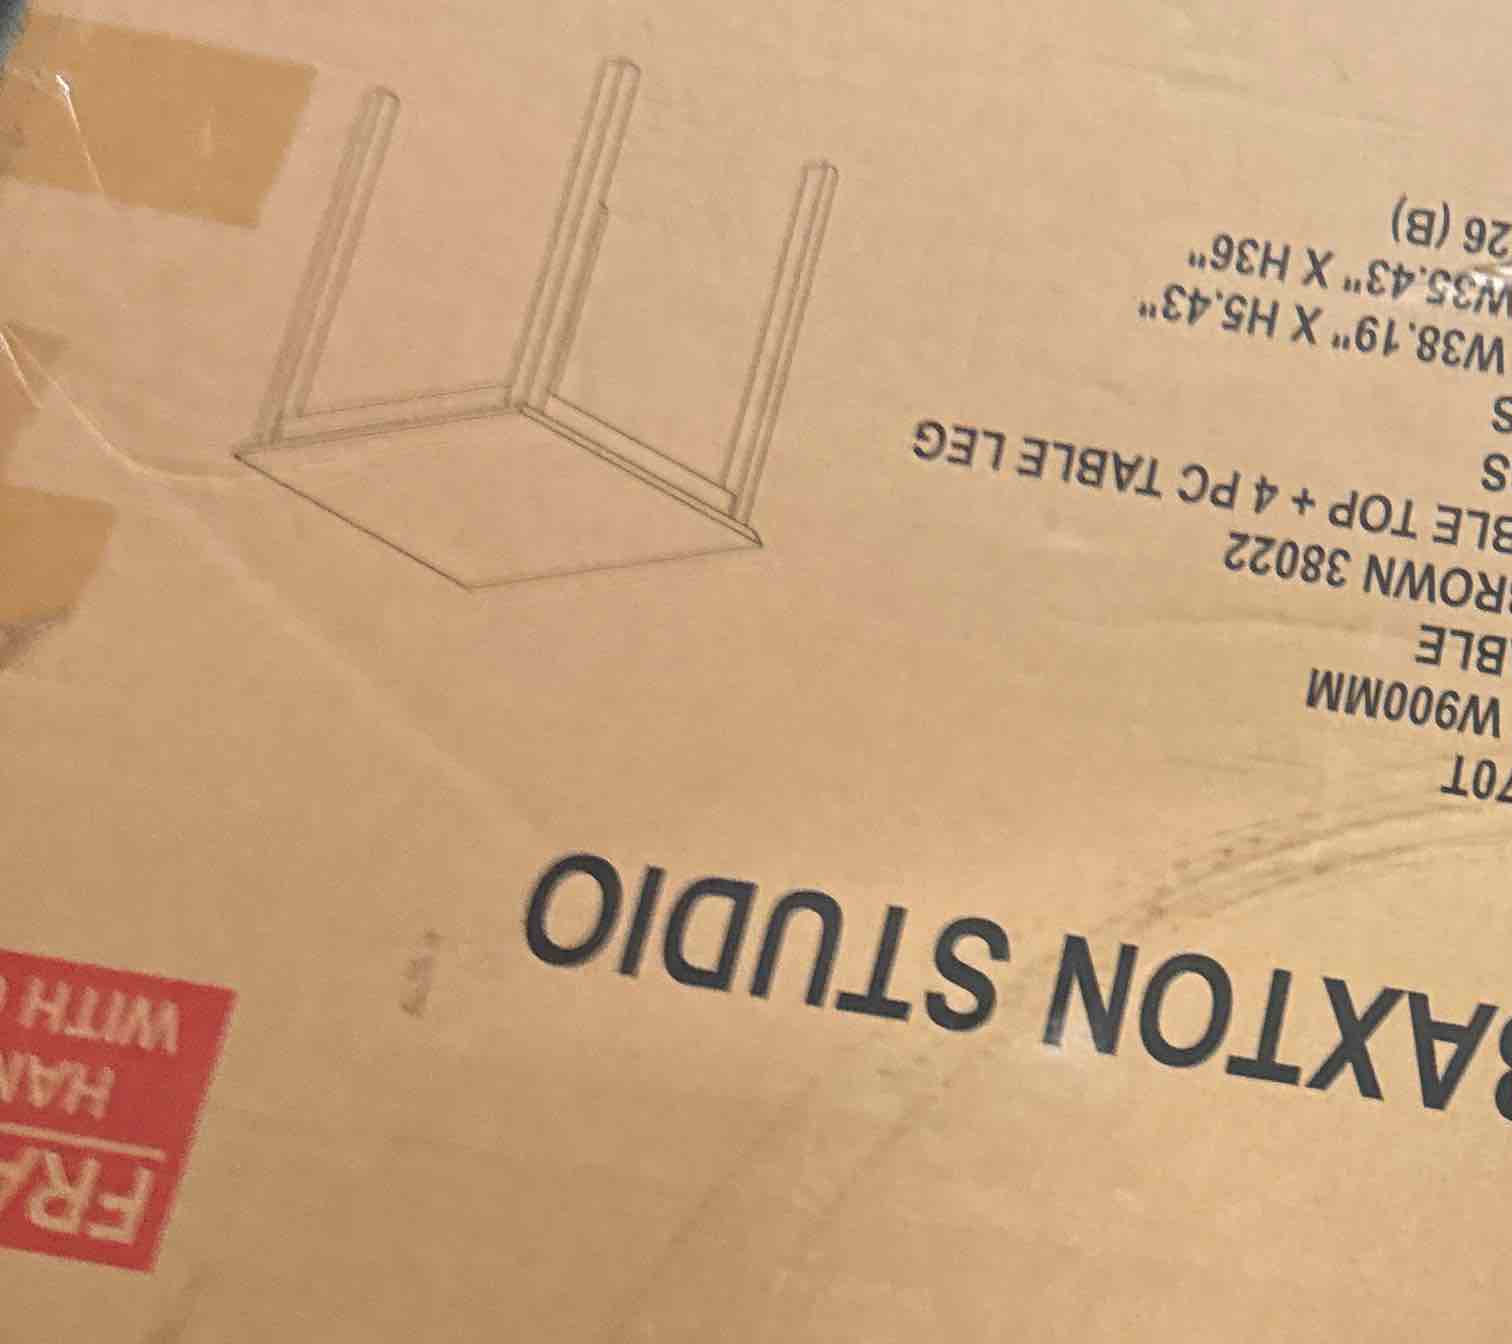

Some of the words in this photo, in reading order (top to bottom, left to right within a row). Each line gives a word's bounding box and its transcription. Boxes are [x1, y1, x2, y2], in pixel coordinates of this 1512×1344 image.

[1391, 194, 1451, 250] (B)
[1187, 233, 1291, 283] H36"
[1301, 247, 1335, 289] X
[1137, 283, 1280, 339] H5.43"
[1290, 303, 1324, 345] X
[1330, 315, 1505, 377] W38.19"
[911, 419, 1007, 472] LEG
[1015, 436, 1162, 500] TABLE
[1177, 463, 1241, 511] PC
[1253, 474, 1279, 515] 4
[1290, 487, 1317, 516] +
[1327, 489, 1418, 541] TOP
[1223, 530, 1352, 589] 38022
[1305, 667, 1501, 740] W900MM
[522, 851, 1011, 1033] STUDIO
[17, 976, 179, 1054] WITH
